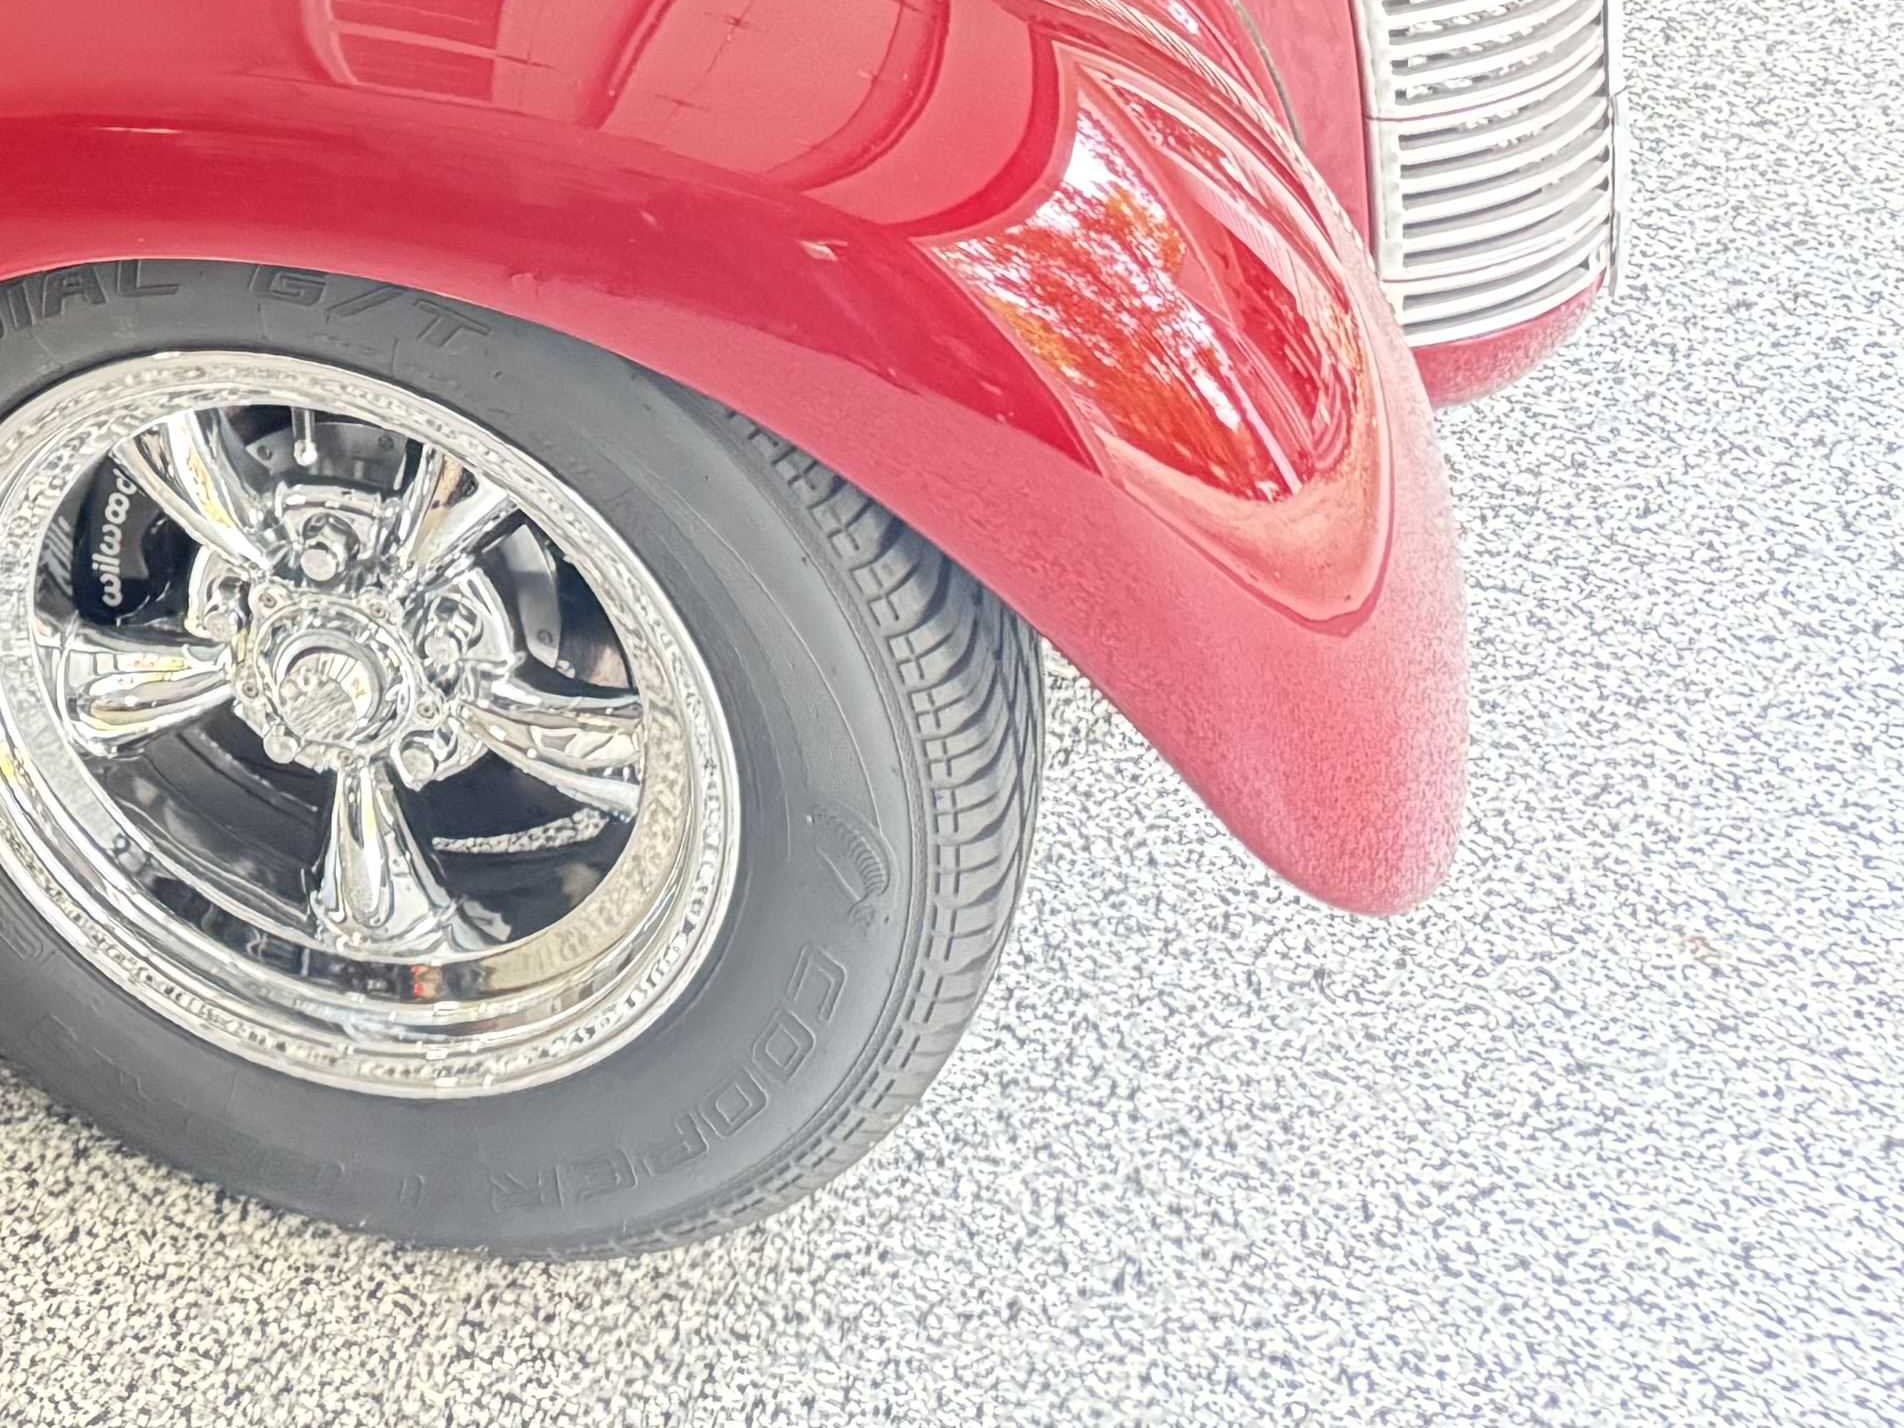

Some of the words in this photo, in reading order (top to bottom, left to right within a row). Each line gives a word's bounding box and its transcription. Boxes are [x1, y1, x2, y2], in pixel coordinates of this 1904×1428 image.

[248, 262, 493, 350] G/T
[92, 467, 137, 608] wilwood
[489, 941, 848, 1215] COOPER
